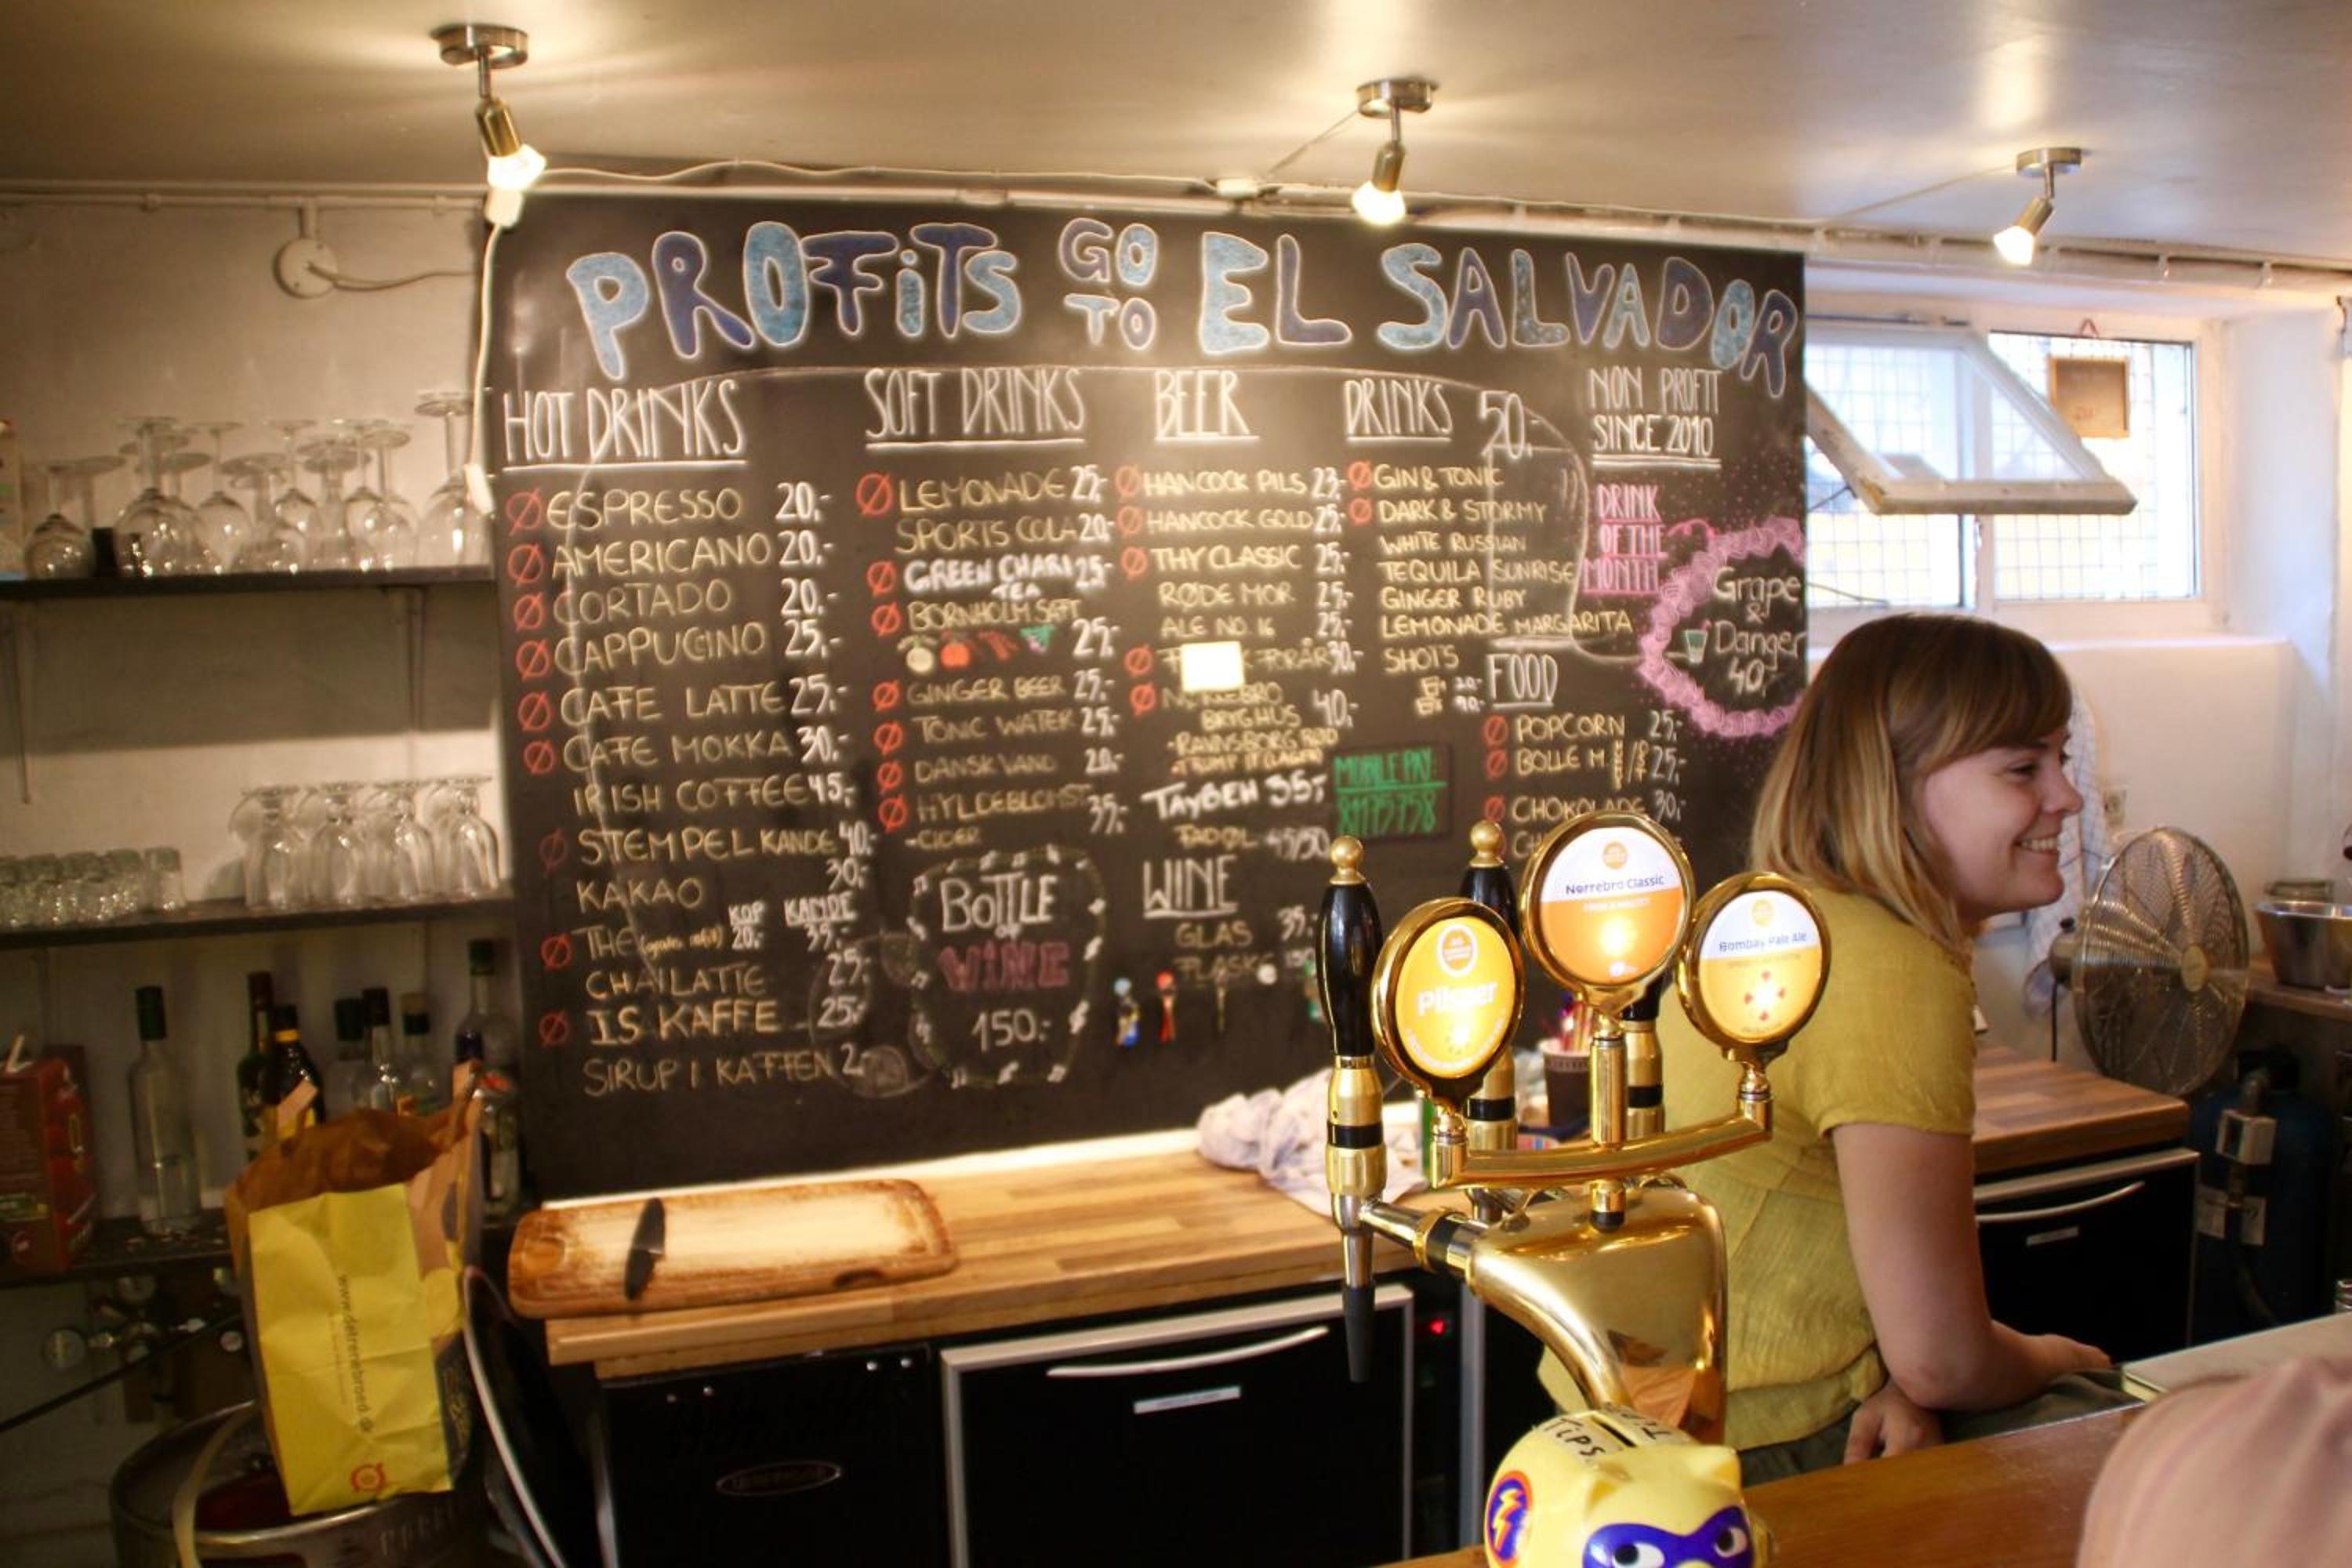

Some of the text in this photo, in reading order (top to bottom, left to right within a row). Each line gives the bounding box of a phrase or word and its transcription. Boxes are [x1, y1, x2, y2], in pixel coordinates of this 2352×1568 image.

[1058, 218, 1158, 286] GO
[1064, 293, 1156, 350] TO
[1199, 230, 1798, 399] EL SALVADOR
[865, 367, 1087, 437] SOFT DRINKS
[1155, 369, 1249, 437] BEER
[1345, 378, 1452, 436] DRINKS
[1588, 367, 1722, 413] NON PROFIT
[500, 379, 746, 460] HOT DRINKS
[1592, 415, 1712, 456] SINCE 2010
[899, 468, 1065, 512] LEMONADE
[1143, 469, 1250, 496] HANCOCK
[1257, 470, 1308, 494] PILS
[1374, 463, 1418, 489] GIN
[1441, 466, 1504, 488] TONIC
[547, 487, 742, 531] ESPRESSO
[1377, 498, 1548, 524] DARK & STORMY
[1597, 484, 1660, 519] DRINK
[895, 517, 1011, 554] SPORTS
[1016, 514, 1077, 543] COLA
[1146, 508, 1255, 535] HANCOCK
[1258, 509, 1315, 529] GOLD
[1600, 522, 1667, 555] OF THE
[552, 532, 772, 579] AMERICANO
[1150, 546, 1208, 572] THY
[1208, 544, 1302, 569] CLASSIC
[1379, 531, 1526, 554] WHITE RUSSIAN
[904, 556, 993, 593] GREEN
[1377, 557, 1576, 583] TEQUILA SUNRISE
[1581, 557, 1660, 591] MONTH
[554, 579, 732, 626] CORTADO
[991, 583, 1042, 601] TEA
[1241, 580, 1297, 606] MOR
[1380, 586, 1527, 610] GINGER RUBY
[1711, 565, 1802, 616] Grape
[907, 598, 1030, 631] BORNHOLM
[1160, 615, 1208, 638] ALE
[1381, 608, 1633, 639] LEMONADE MARGARITA
[1382, 644, 1460, 676] SHOTS
[1714, 621, 1806, 669] Danger
[907, 677, 1009, 705] GINGER
[1014, 675, 1066, 700] BEER
[1487, 652, 1559, 703] FOOD
[561, 685, 664, 728] CAFE
[686, 681, 785, 718] LATTE
[1201, 704, 1301, 731] BRYGHUS
[912, 715, 988, 744] TONIC
[996, 708, 1076, 737] WATER
[1515, 713, 1626, 742] POPCORN
[563, 734, 659, 772] CAFE
[672, 730, 792, 764] MOKKA
[914, 755, 996, 783] DANSK
[998, 753, 1057, 776] VAND
[1516, 746, 1581, 776] BOLLE
[572, 783, 663, 816] IRISH
[676, 772, 811, 812] COFFEE
[579, 826, 753, 866] STEMPEL
[760, 828, 837, 856] KANDE
[576, 877, 703, 914] KAKAO
[1142, 853, 1239, 911] WINE
[1566, 872, 1664, 896] Nørrebro Classic
[728, 901, 766, 927] KOP
[783, 891, 858, 927] KANDE
[1176, 920, 1254, 949] GLAS
[586, 1005, 641, 1047] IS
[658, 996, 783, 1042] KAFFE
[583, 1056, 677, 1098] SIRUP
